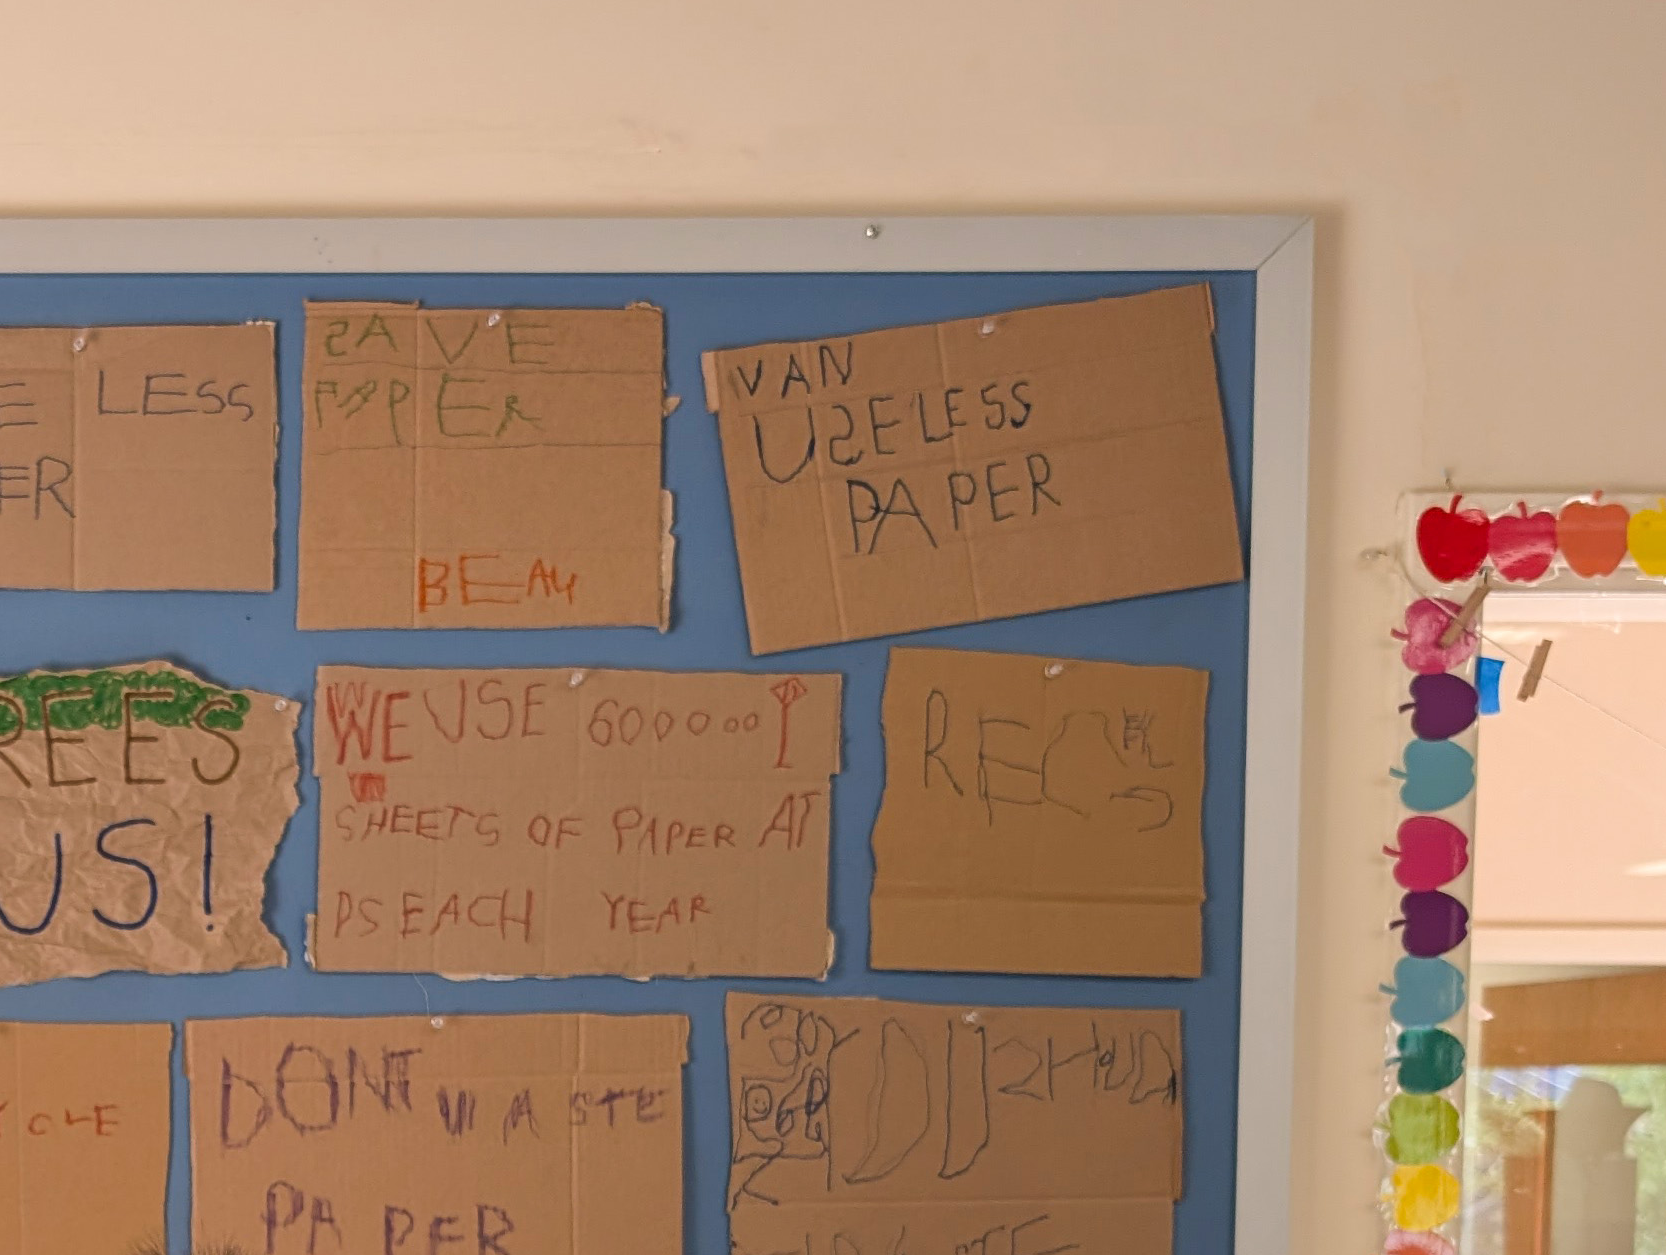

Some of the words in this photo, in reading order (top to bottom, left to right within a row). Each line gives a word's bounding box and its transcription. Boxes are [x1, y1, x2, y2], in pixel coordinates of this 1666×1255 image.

[96, 369, 254, 423] LESS
[736, 341, 854, 399] VAN
[313, 372, 547, 446] PAPER
[846, 453, 1062, 556] PAPER
[325, 681, 414, 766] WE
[423, 678, 548, 745] USE
[335, 803, 501, 847] SHEETS
[527, 814, 586, 850] OF
[610, 806, 736, 856] PAPER
[757, 791, 823, 850] AT
[400, 888, 534, 944] EACH
[600, 891, 712, 935] YEAR
[220, 1041, 422, 1152] DONT
[437, 1085, 669, 1146] WASTE
